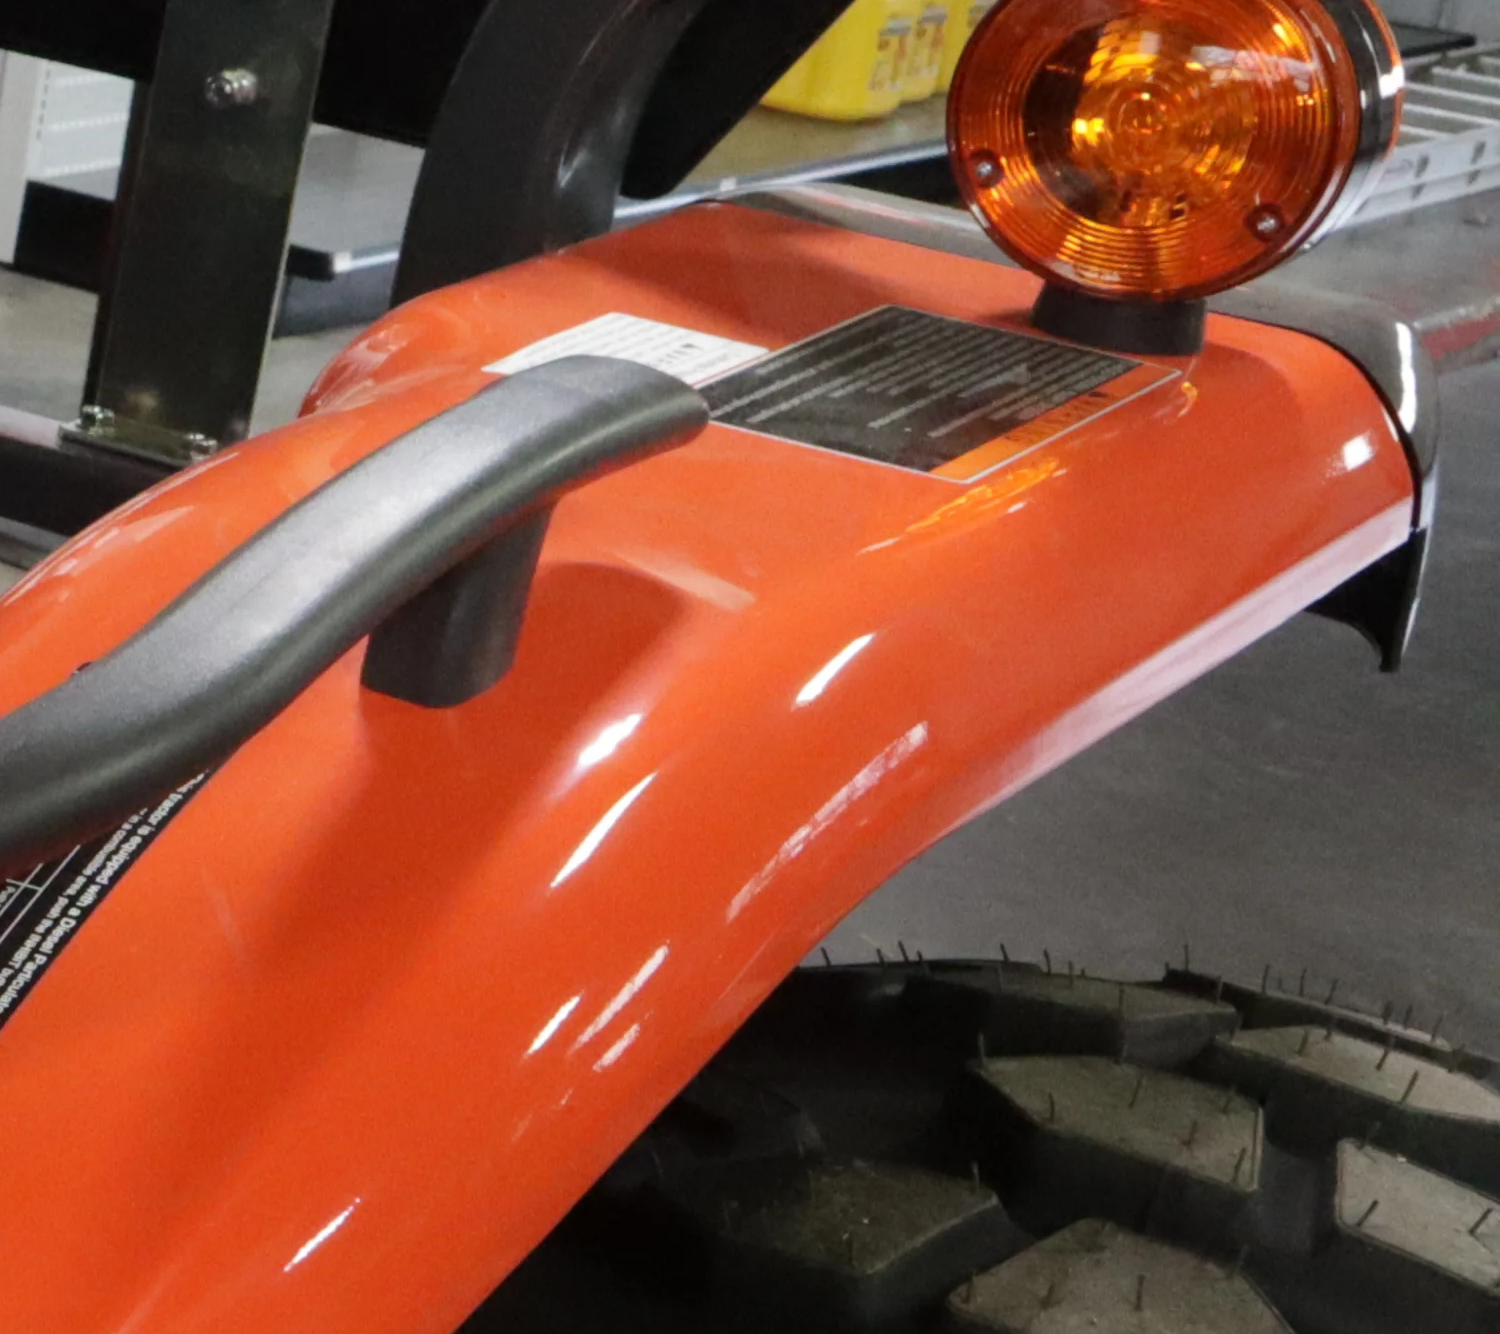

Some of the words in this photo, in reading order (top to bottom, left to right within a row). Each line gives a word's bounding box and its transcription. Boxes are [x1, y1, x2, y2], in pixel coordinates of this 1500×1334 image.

[146, 790, 182, 826] tractor
[93, 833, 143, 886] equipped
[75, 883, 102, 908] with
[38, 916, 75, 954] Diesel
